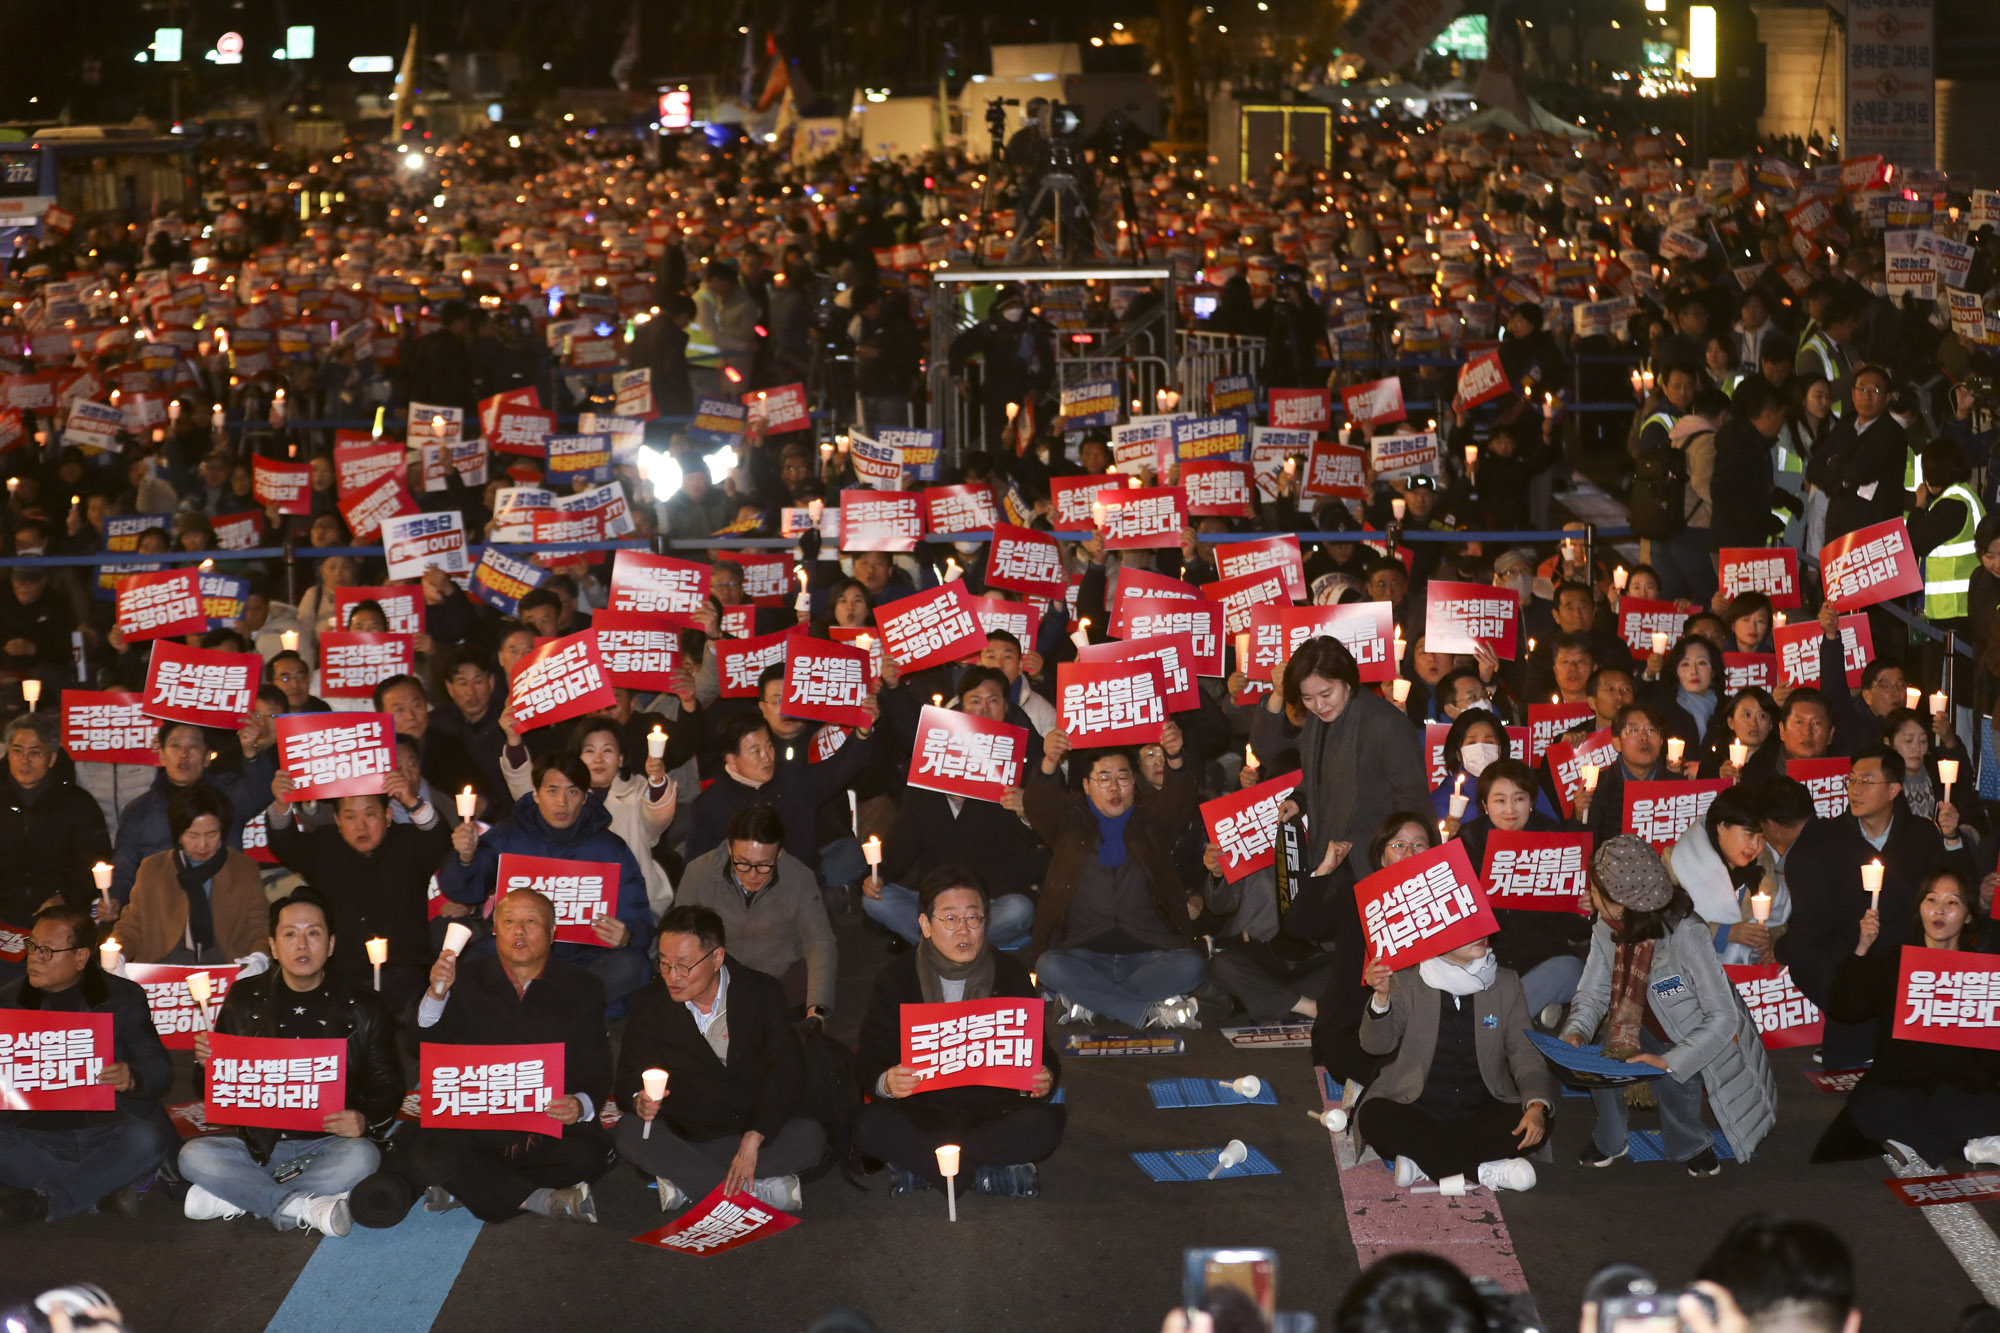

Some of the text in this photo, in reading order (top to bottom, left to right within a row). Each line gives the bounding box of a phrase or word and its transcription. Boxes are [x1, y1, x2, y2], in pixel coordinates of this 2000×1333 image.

[1851, 44, 1930, 69] 광화문 교차로
[1893, 101, 1929, 125] 교차로
[7, 167, 33, 183] 272
[1117, 423, 1166, 444] 국정농단
[1176, 419, 1238, 442] 김건희를
[1260, 432, 1311, 446] 국정농단
[548, 436, 605, 454] 김건희를
[852, 438, 894, 462] 국정농단
[902, 448, 939, 465] 하라!
[1178, 434, 1246, 459] 특검하라!
[1377, 436, 1428, 454] 국정농단
[1405, 450, 1436, 467] OUT!
[868, 462, 899, 477] OUT!
[1315, 454, 1362, 473] 윤석열을
[1185, 470, 1246, 491] 윤석열을
[1312, 469, 1366, 487] 거부한다!
[845, 499, 916, 522] 국정농단
[930, 489, 993, 517] 국정농단
[1105, 496, 1174, 523] 윤석열을
[1186, 487, 1250, 506] 거부한다!
[391, 514, 452, 539] 국정농단
[537, 516, 599, 541] 국정농단
[1105, 513, 1181, 540] 거부한다!
[429, 533, 462, 552] OUT!
[998, 539, 1060, 567] 윤석열을
[481, 547, 541, 586] 김건희를
[992, 558, 1063, 584] 거부한다!
[1723, 558, 1786, 583] 윤석열을
[1824, 530, 1905, 585] 김건희특검
[200, 576, 239, 597] 희를
[475, 563, 534, 599] 특검하라
[617, 565, 701, 592] 국정농단
[1723, 575, 1793, 600] 거부한다!
[1826, 557, 1899, 602] 수용하라!
[119, 576, 189, 611] 국정농단
[1222, 577, 1283, 616] 건희특검
[119, 596, 199, 634] 규명하라!
[203, 600, 244, 619] 하라!
[882, 591, 959, 640] 국정농단
[1624, 613, 1690, 633] 윤석열을
[889, 609, 976, 666] 규명하라!
[1130, 611, 1212, 640] 윤석열을
[326, 640, 405, 666] 국정농단
[597, 630, 679, 652] 김건희특검
[1781, 627, 1858, 664] 윤석을
[157, 660, 248, 691] 윤석열을
[512, 640, 588, 697] 국정농단
[792, 655, 863, 683] 윤석열을
[1724, 663, 1768, 687] 농단
[1784, 649, 1867, 687] 거부다!
[151, 683, 250, 714] 거부한다!
[512, 665, 603, 722] 규명하라!
[788, 680, 868, 707] 거부한다
[1063, 671, 1154, 710] 윤석열을
[68, 702, 153, 728] 국정농단
[1063, 697, 1165, 736] 거부한다!
[68, 725, 156, 751] 규명하라
[284, 721, 383, 761] 국정농단
[923, 728, 1016, 762] 윤석열을
[286, 747, 392, 790] 규명하라!
[918, 751, 1017, 787] 거부한다!
[1557, 743, 1619, 785] 김건희
[1632, 790, 1718, 823] 윤석열을
[1632, 817, 1697, 844] 거부한
[1487, 845, 1583, 876] 윤석열을
[1485, 868, 1586, 897] 거부한다!
[1363, 860, 1459, 937] 윤석열을
[553, 901, 609, 926] 한다!
[1367, 884, 1478, 958] 거부한다!
[1736, 974, 1806, 1008] 정농단
[1754, 998, 1820, 1034] 명하라!
[910, 1008, 1028, 1053] 국정농단
[212, 1055, 339, 1084] 채상병특검
[910, 1038, 1034, 1081] 규명하라!
[431, 1059, 545, 1093] 윤석열을
[212, 1082, 320, 1110] 추진하라!
[431, 1086, 553, 1117] 거부한다!
[660, 1200, 746, 1249] 윤석열을
[689, 1206, 774, 1253] 거부한다!
